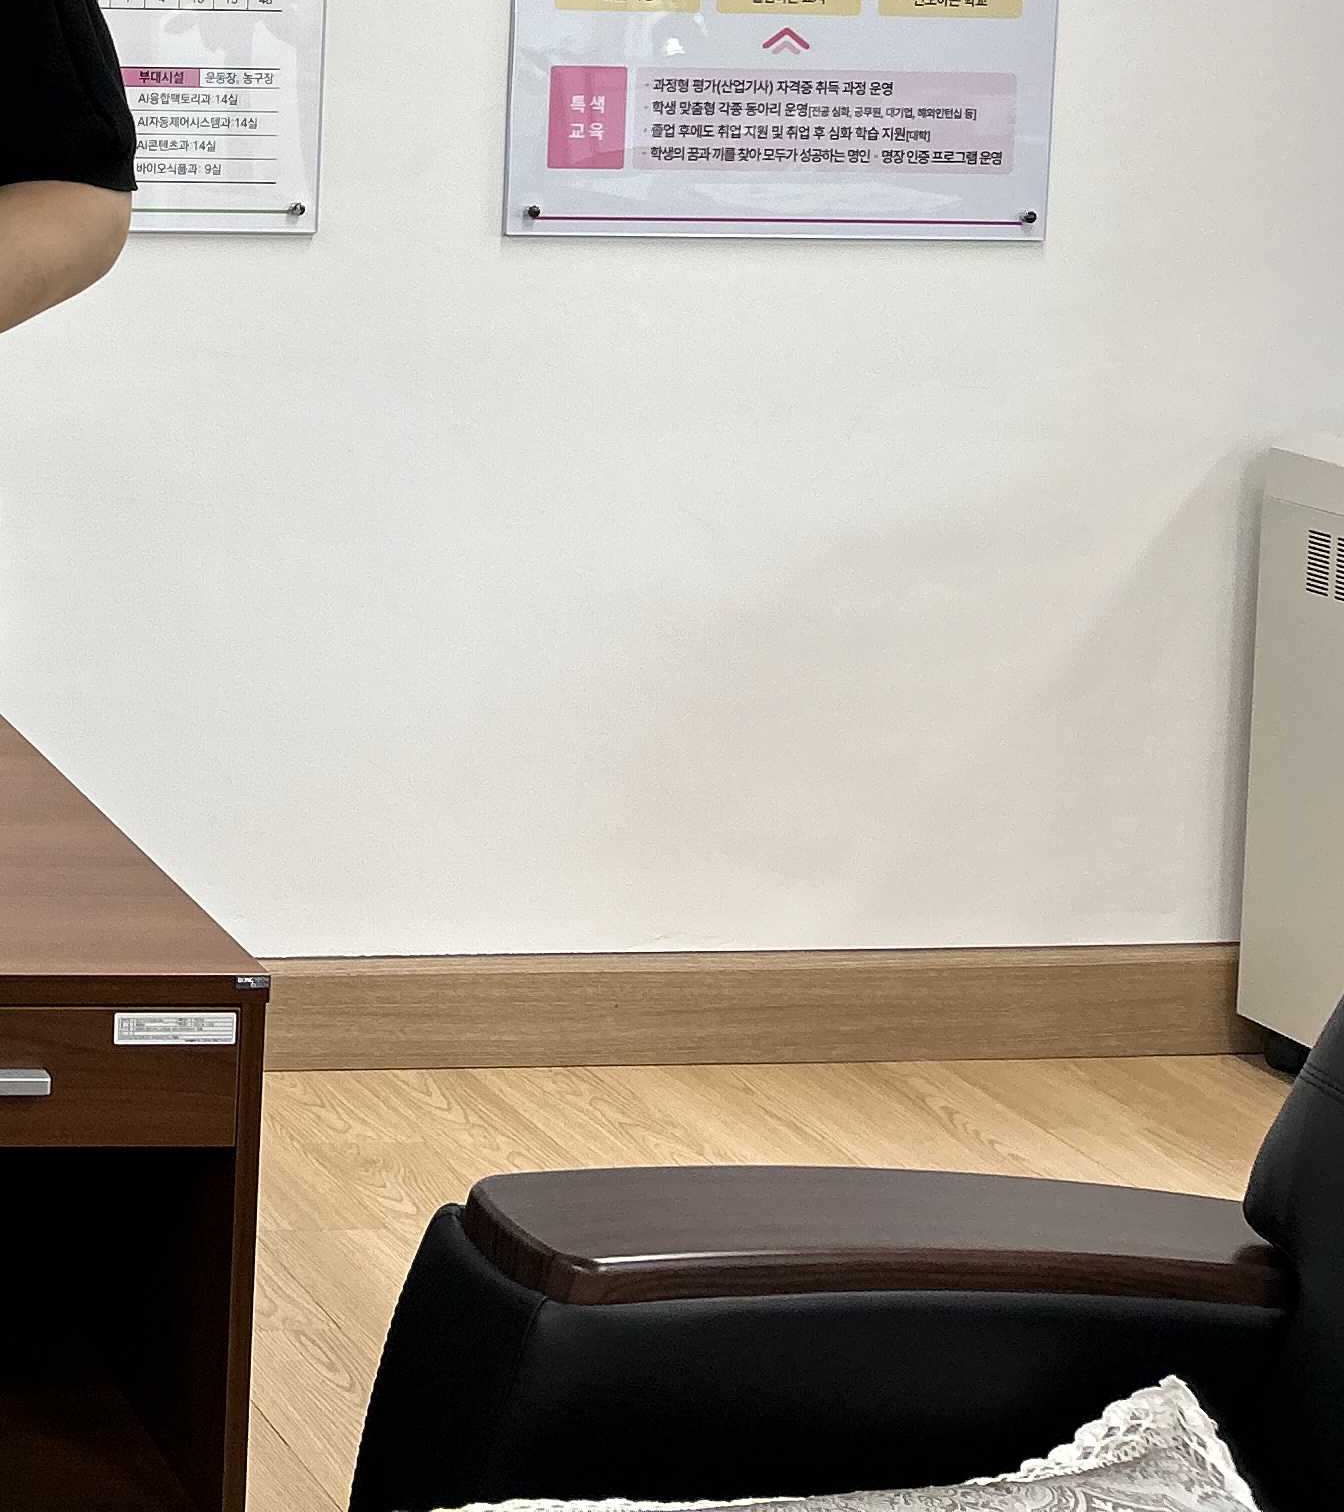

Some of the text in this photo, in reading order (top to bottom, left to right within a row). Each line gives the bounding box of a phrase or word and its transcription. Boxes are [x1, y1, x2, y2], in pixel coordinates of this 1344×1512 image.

[138, 71, 184, 84] 부대시설
[653, 79, 893, 96] 과정형 자격증 과정 운영
[652, 101, 676, 115] 학생
[718, 124, 879, 140] 취업 지원 취업 후 심화 학습
